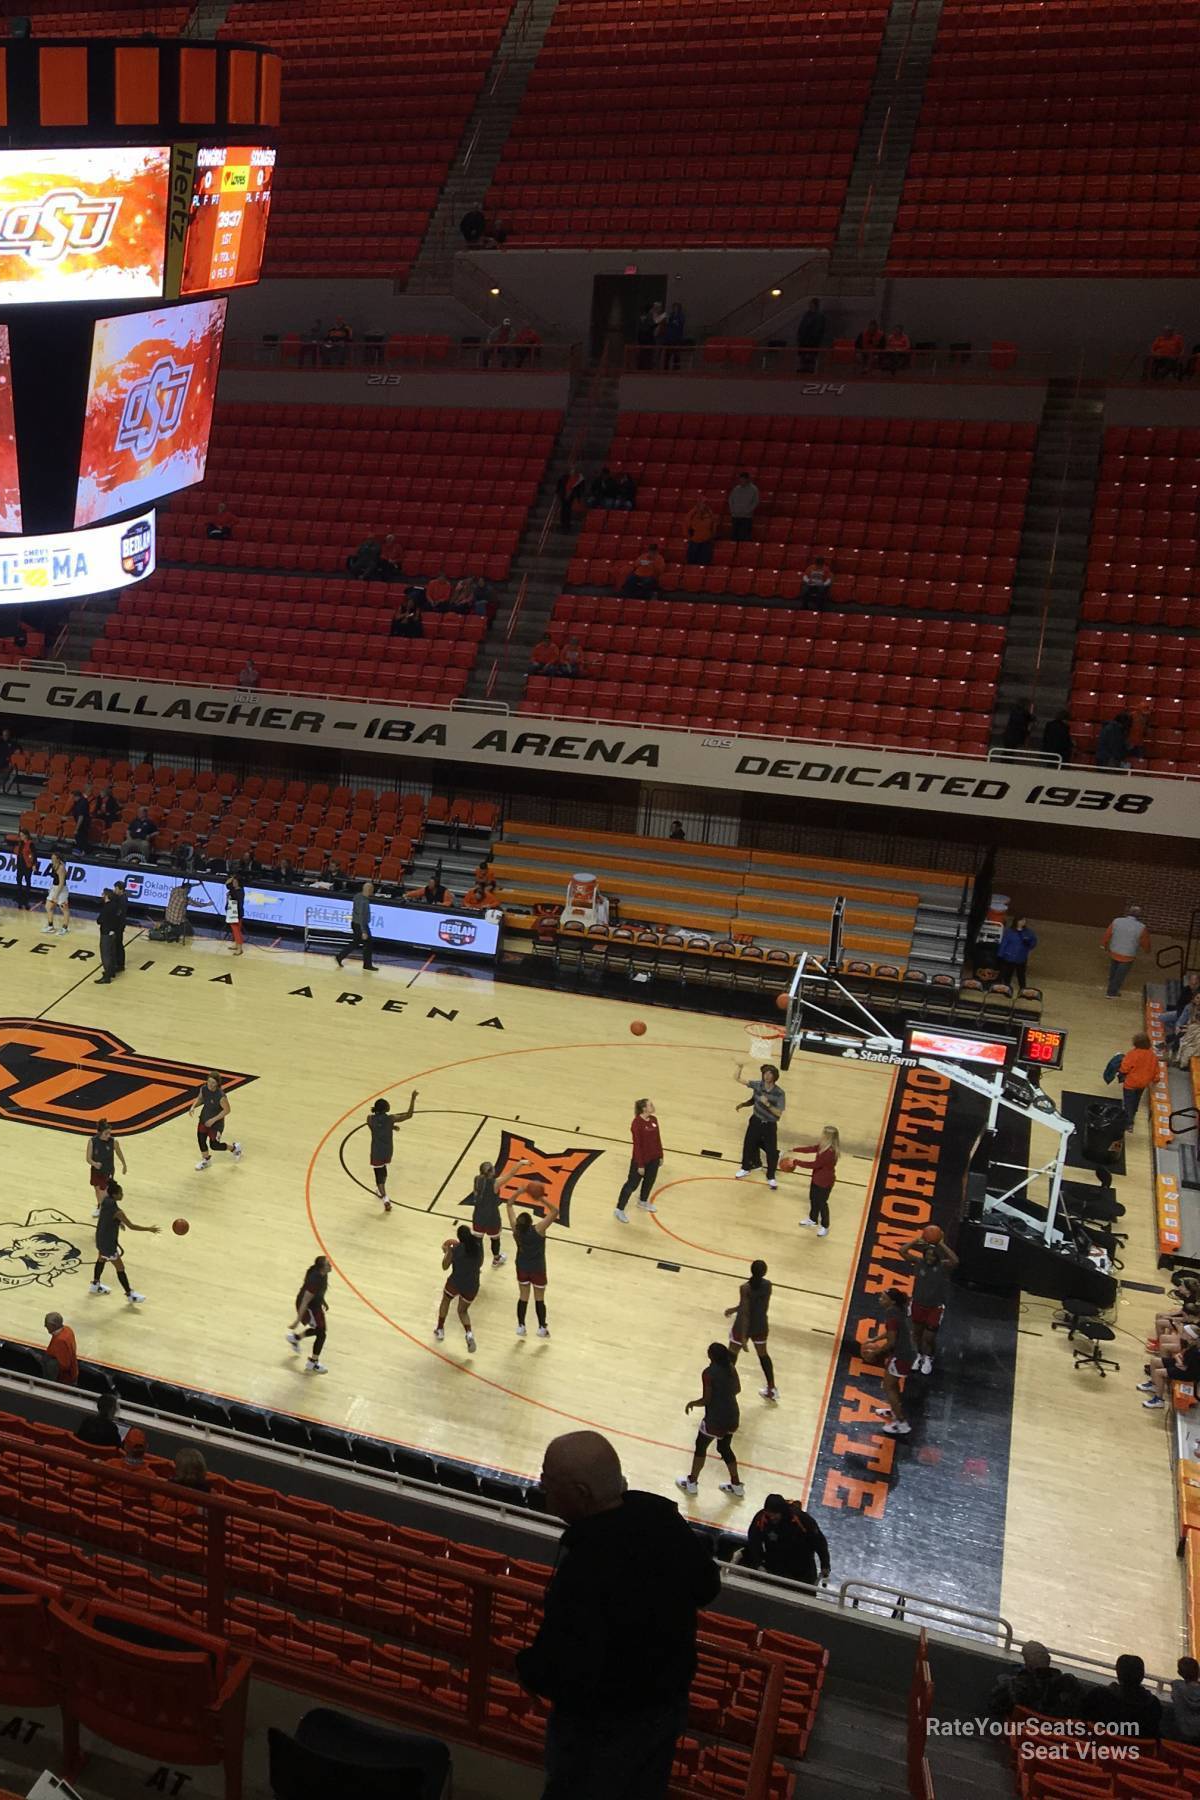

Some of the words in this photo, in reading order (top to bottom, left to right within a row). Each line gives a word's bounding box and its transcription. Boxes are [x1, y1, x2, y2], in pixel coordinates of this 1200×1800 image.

[170, 148, 194, 242] Hertz
[367, 373, 402, 386] 213
[801, 382, 847, 397] 214
[114, 355, 194, 461] OSU
[473, 728, 661, 768] ARENA
[735, 755, 1011, 801] DEDICATED
[1025, 785, 1155, 816] 1938
[144, 889, 168, 899] Blood
[440, 922, 477, 936] BEDLAM
[139, 960, 236, 986] IBA
[290, 986, 506, 1031] ARENA
[1027, 1029, 1061, 1046] 39:36
[1030, 1042, 1053, 1061] 30
[864, 1066, 951, 1300] OKLAHOMA
